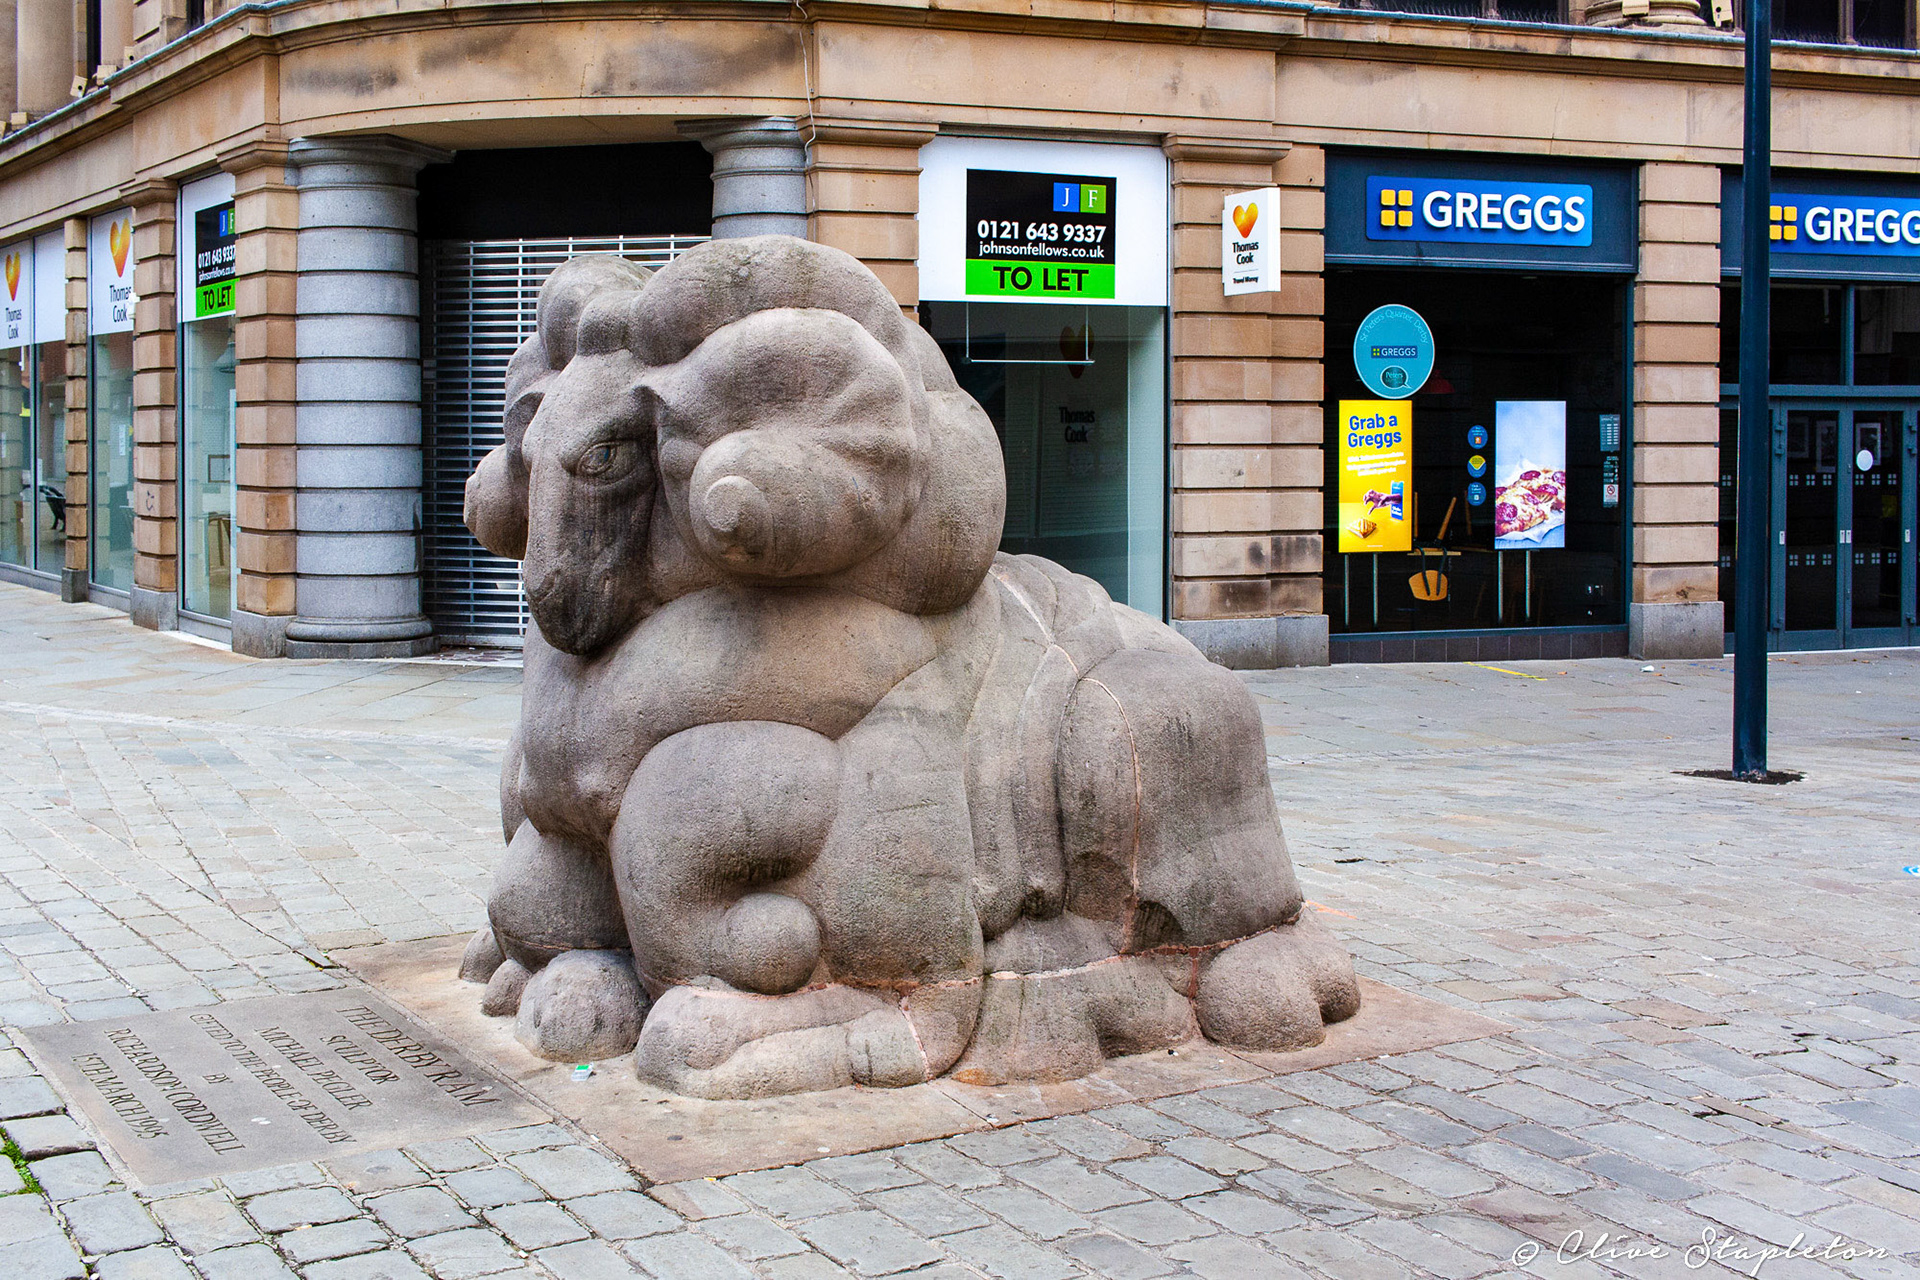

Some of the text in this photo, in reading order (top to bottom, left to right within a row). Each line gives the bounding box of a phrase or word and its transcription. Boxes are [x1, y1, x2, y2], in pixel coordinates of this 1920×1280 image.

[1422, 190, 1585, 233] GREGGS
[977, 219, 1107, 243] 0121 643 9337
[198, 244, 236, 269] 0121 643 9337
[979, 241, 1105, 259] johnsonfellows.co.uk
[1232, 241, 1259, 253] Thomas
[1236, 252, 1254, 265] Cook
[992, 266, 1089, 292] TO LET
[203, 285, 232, 311] TO LET
[5, 307, 22, 322] Thomas
[112, 303, 128, 323] Cook
[8, 324, 19, 339] Cook
[1364, 314, 1385, 333] Peters
[1413, 319, 1429, 344] Derby
[1381, 347, 1416, 356] GREGGS
[1058, 406, 1095, 424] Thomas
[1349, 413, 1398, 431] Grab a
[1065, 425, 1088, 443] Cook
[1348, 431, 1402, 449] Greggs
[319, 1034, 401, 1085] SCULPTOR
[336, 1005, 502, 1107] THE DERBY RAM
[189, 1013, 358, 1144] GIFTED TO THE PEOPLE OF DERBY
[202, 1072, 234, 1084] BY
[254, 1026, 374, 1111] MICHAEL PEGLER
[103, 1027, 246, 1156] RICHARDSON CORDWELL
[93, 1074, 151, 1119] MARCH
[125, 1114, 169, 1140] 1995
